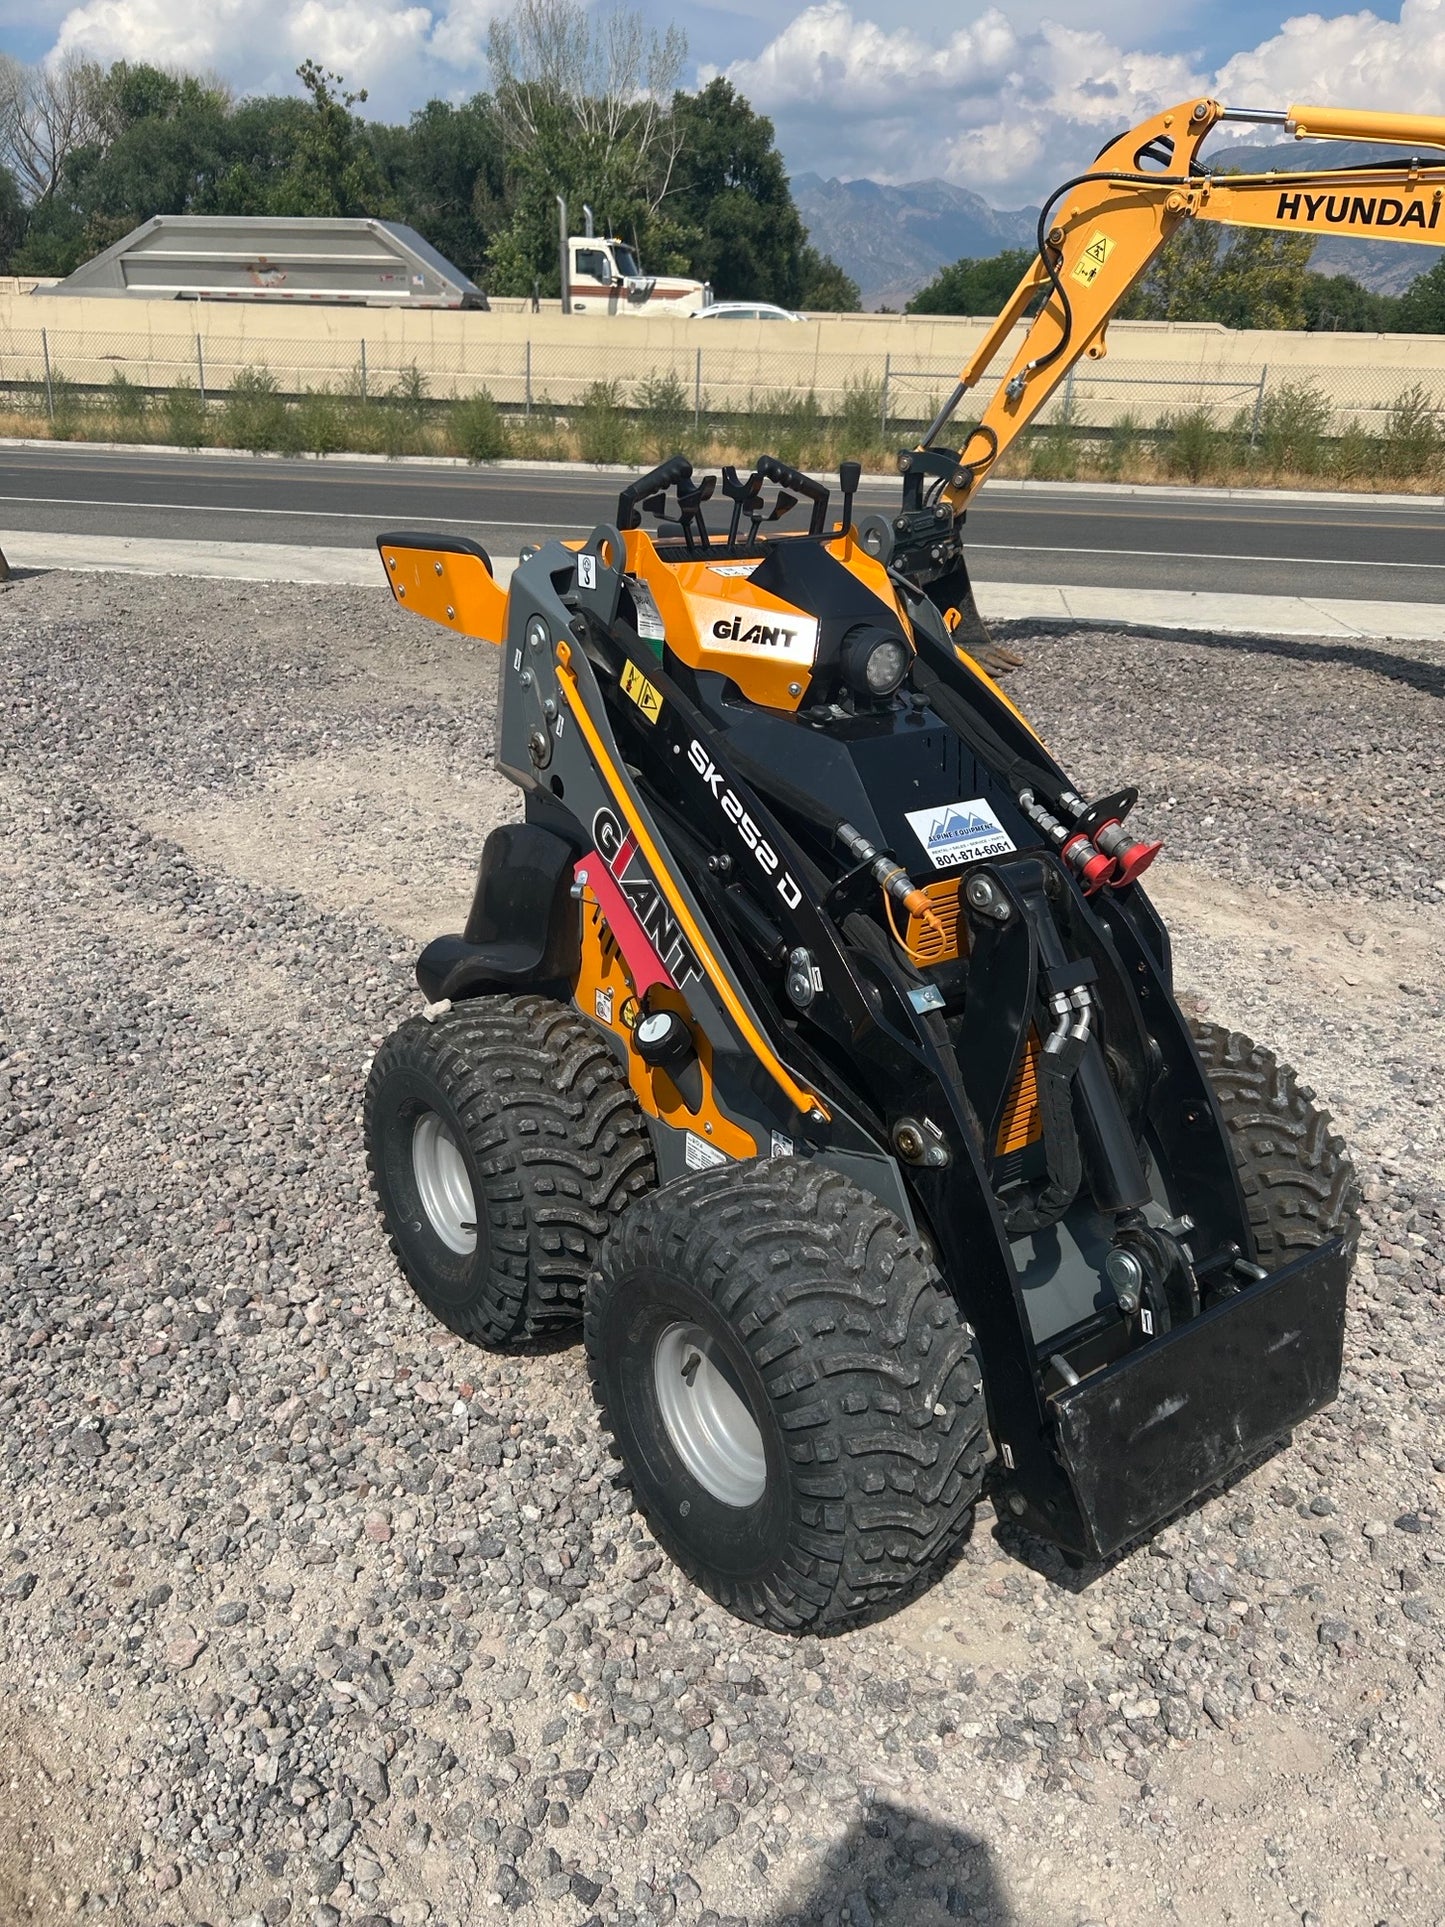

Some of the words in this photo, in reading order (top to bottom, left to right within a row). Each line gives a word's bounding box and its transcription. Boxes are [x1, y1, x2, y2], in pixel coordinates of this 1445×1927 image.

[1276, 193, 1441, 229] HYUNDAI
[928, 832, 953, 843] ALPINE
[955, 823, 994, 836] EQUIPMENT
[936, 841, 1012, 866] 801-874-6061
[776, 871, 803, 910] D
